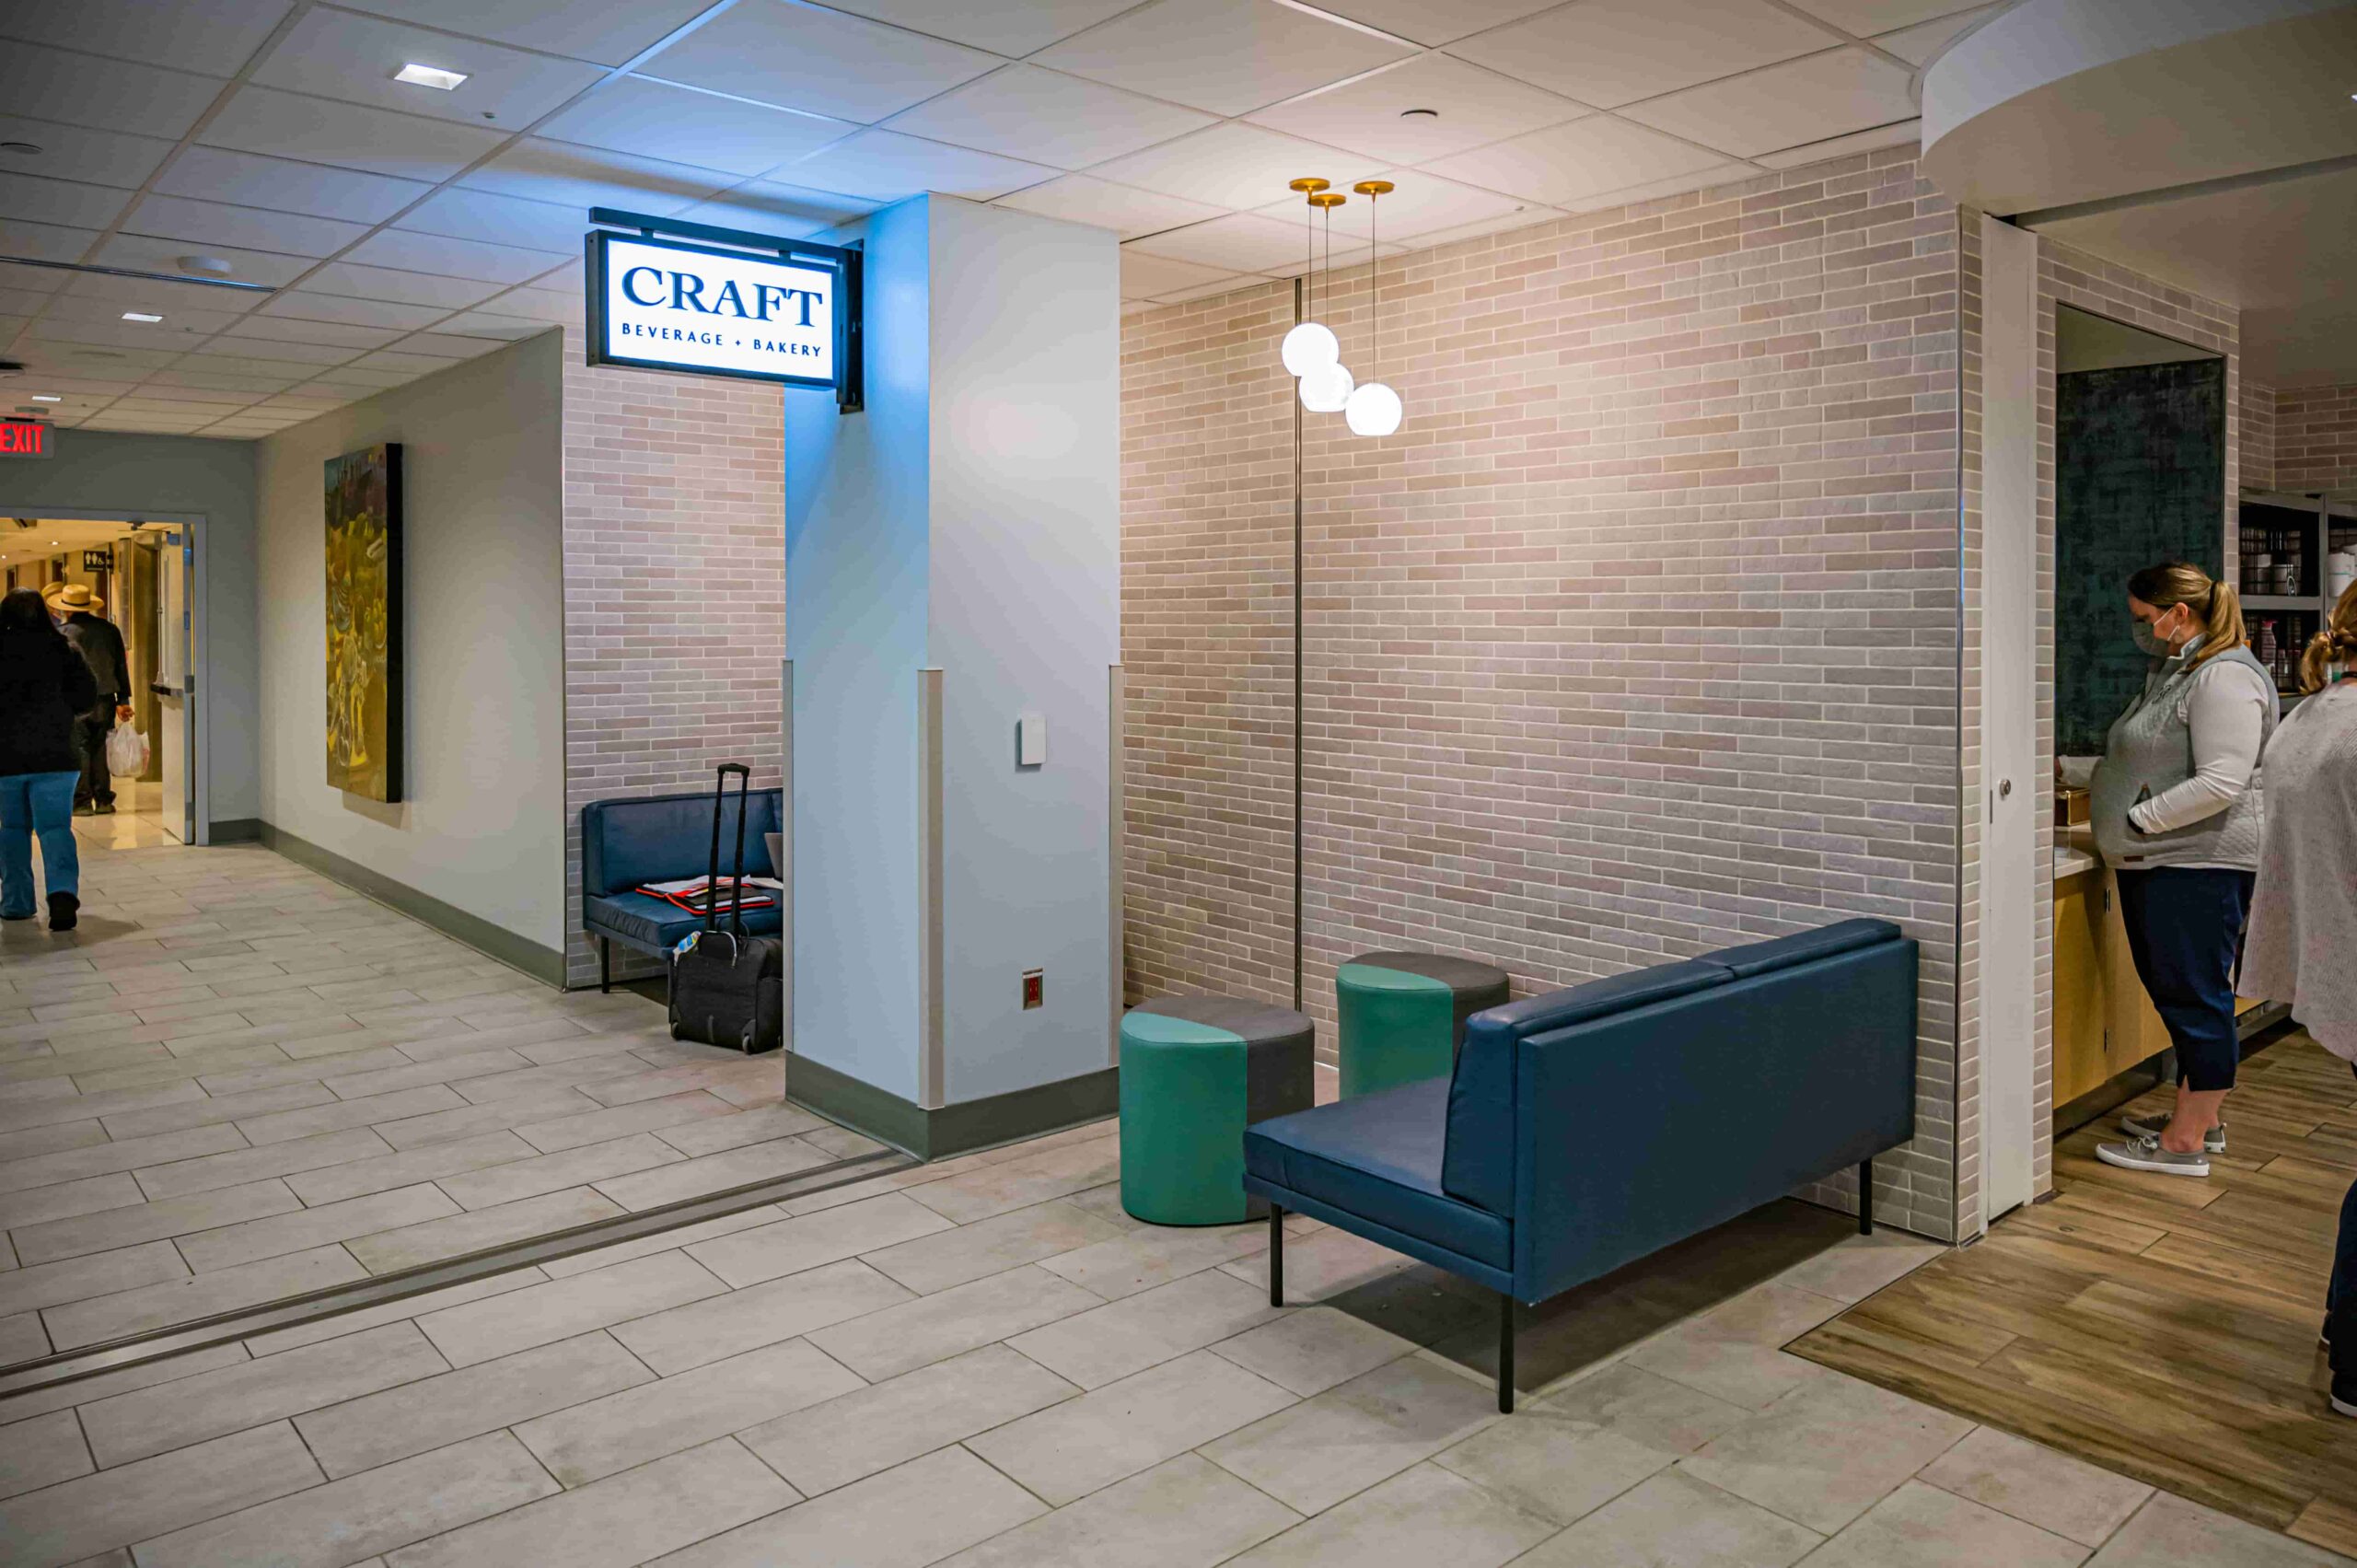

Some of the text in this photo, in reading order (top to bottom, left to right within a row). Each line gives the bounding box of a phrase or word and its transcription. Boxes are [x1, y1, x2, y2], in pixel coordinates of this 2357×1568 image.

[621, 266, 823, 328] CRAFT
[621, 322, 724, 346] BEVERAGE
[753, 339, 821, 357] BAKERY
[0, 423, 44, 454] EXIT
